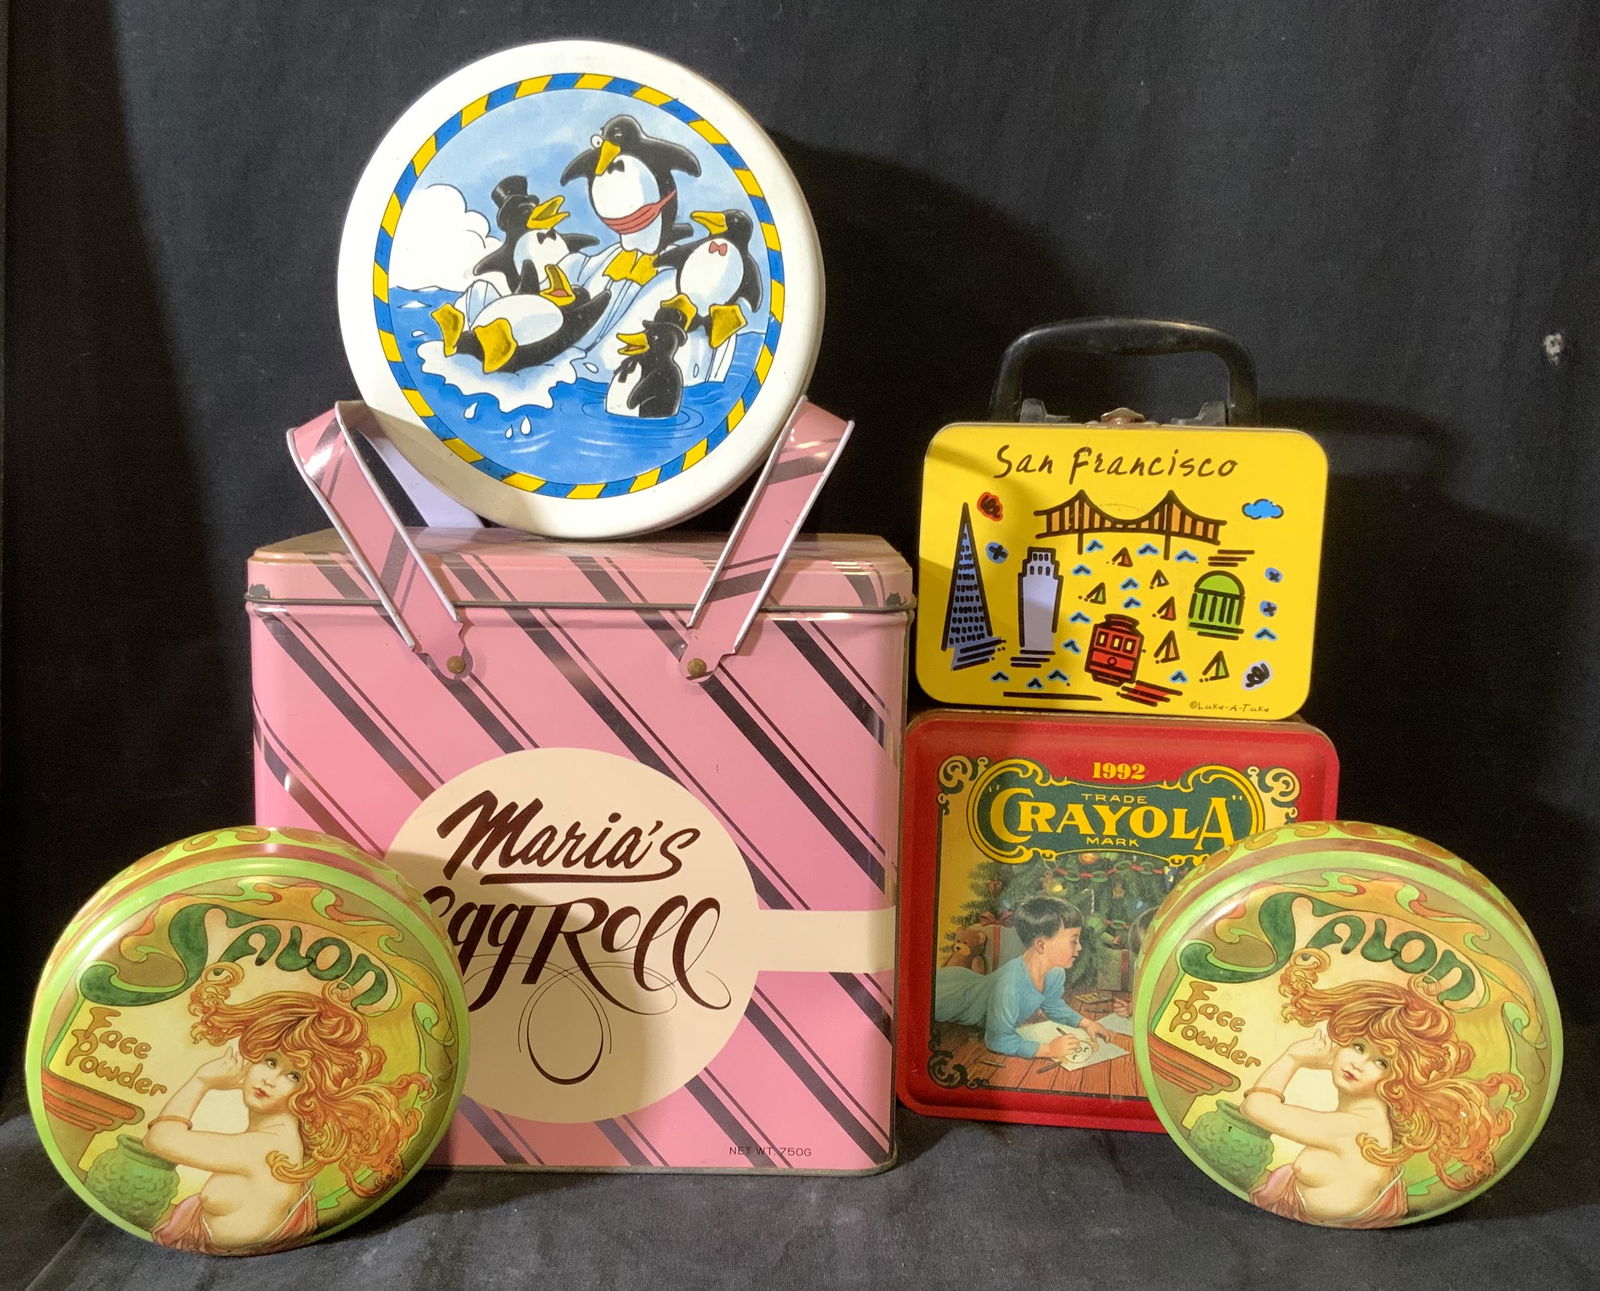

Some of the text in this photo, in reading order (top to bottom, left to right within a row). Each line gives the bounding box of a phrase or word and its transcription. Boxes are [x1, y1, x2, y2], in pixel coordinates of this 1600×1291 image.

[993, 444, 1238, 485] San Francisco
[1092, 761, 1146, 781] 1992
[1081, 793, 1148, 805] TRADE
[436, 789, 702, 881] Maria's
[1086, 836, 1140, 848] MARK
[1184, 980, 1246, 1033] Face
[83, 1006, 152, 1060] Face
[1169, 999, 1261, 1068] Powder
[65, 1028, 168, 1097] Powder
[729, 1147, 753, 1156] NET
[779, 1147, 812, 1157] 750G
